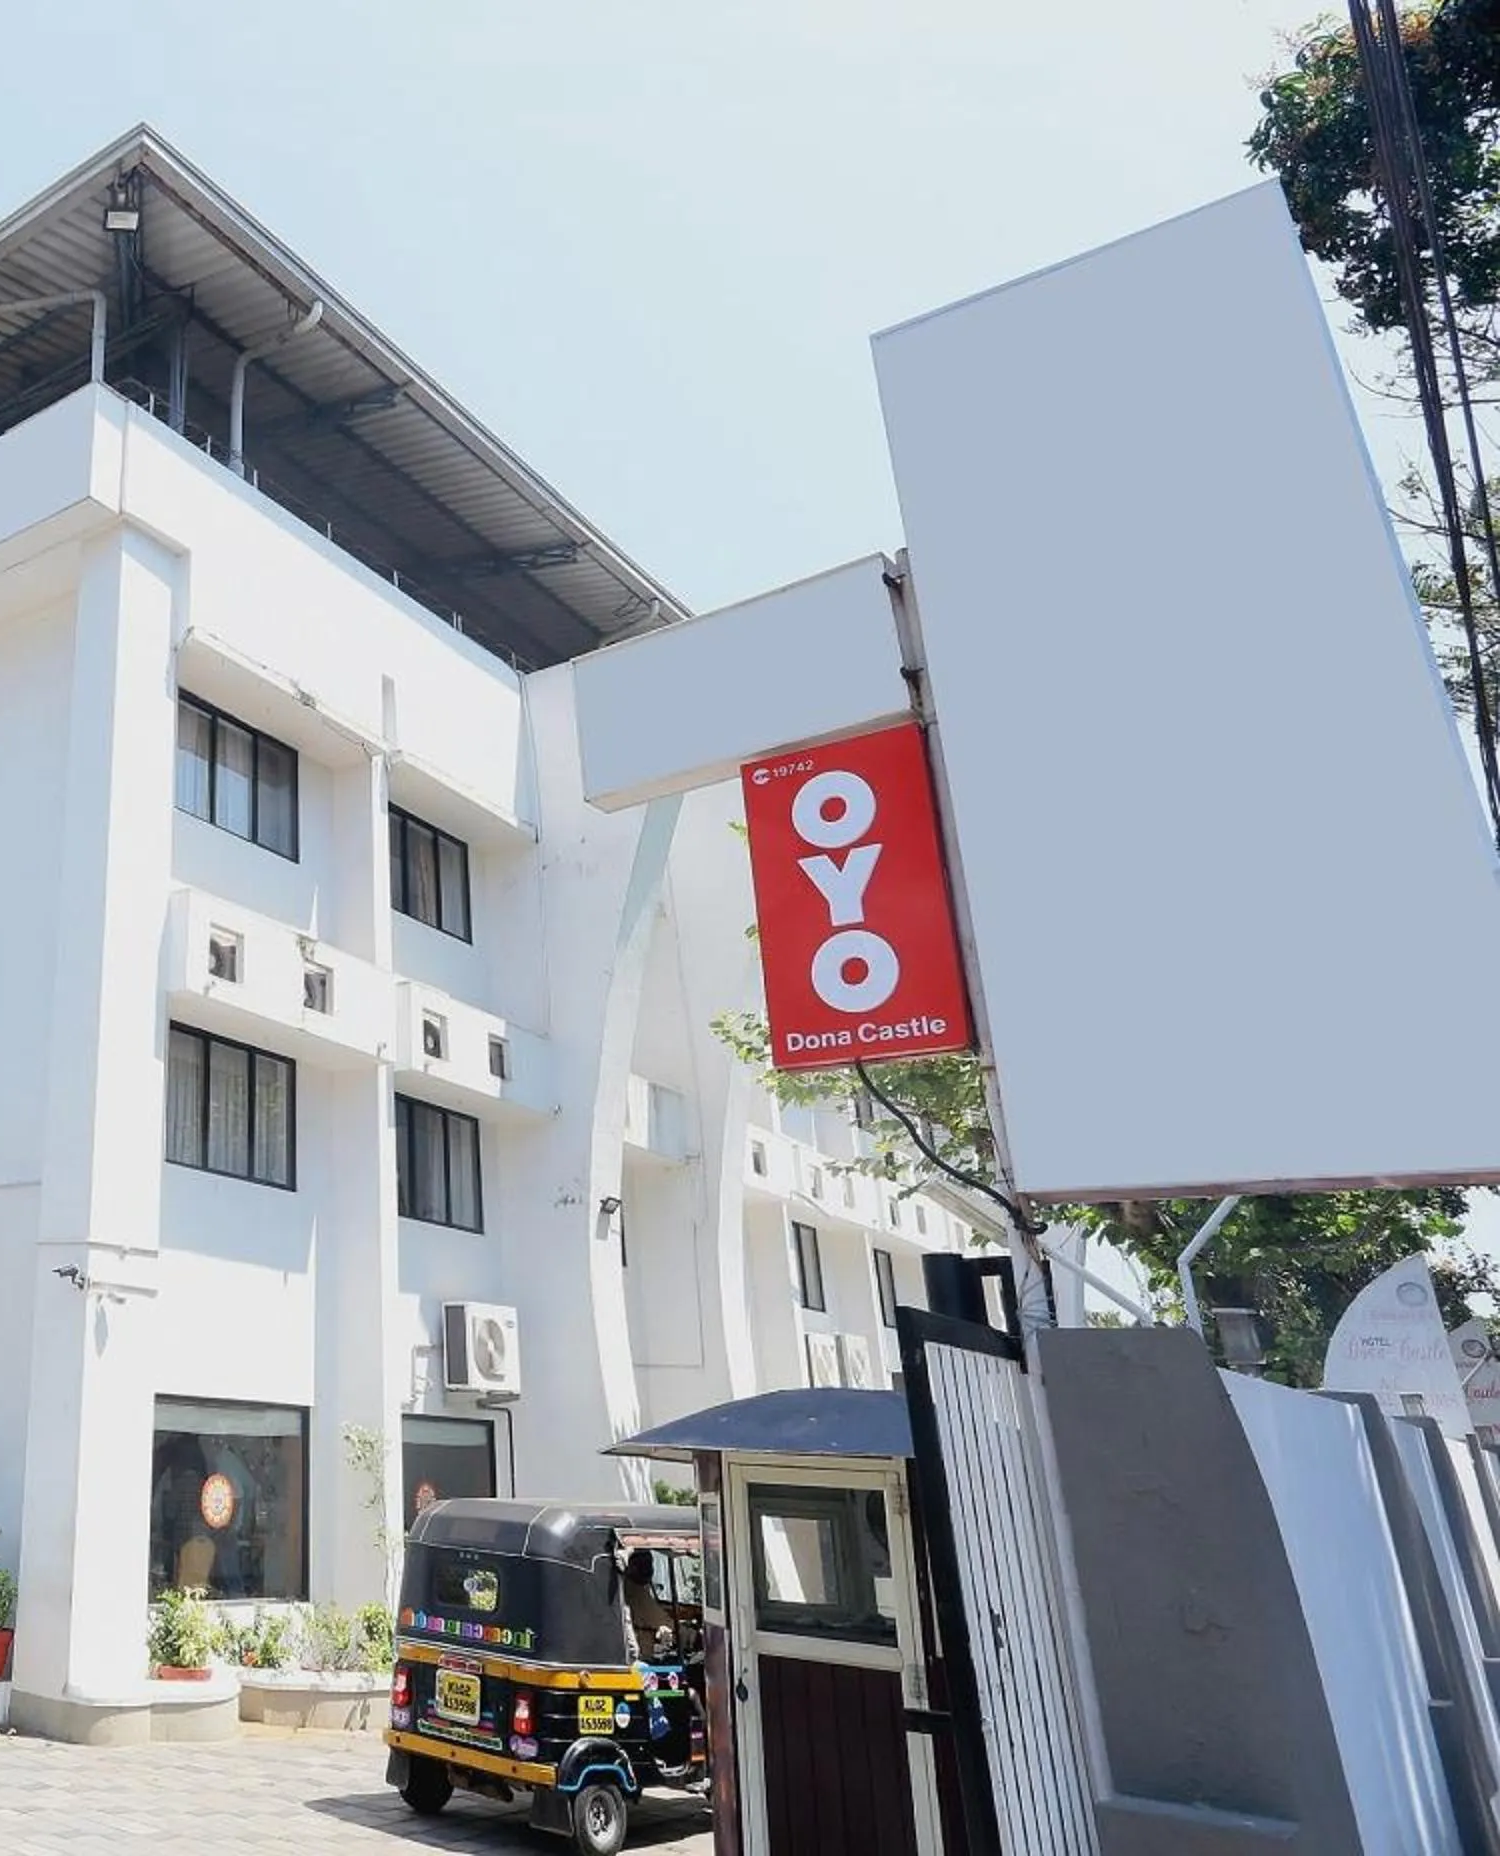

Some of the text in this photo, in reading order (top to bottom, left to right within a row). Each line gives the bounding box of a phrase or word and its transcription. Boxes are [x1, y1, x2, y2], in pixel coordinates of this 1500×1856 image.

[772, 760, 815, 777] 19742
[791, 770, 900, 1013] OYO
[786, 1015, 947, 1053] Dona Castle
